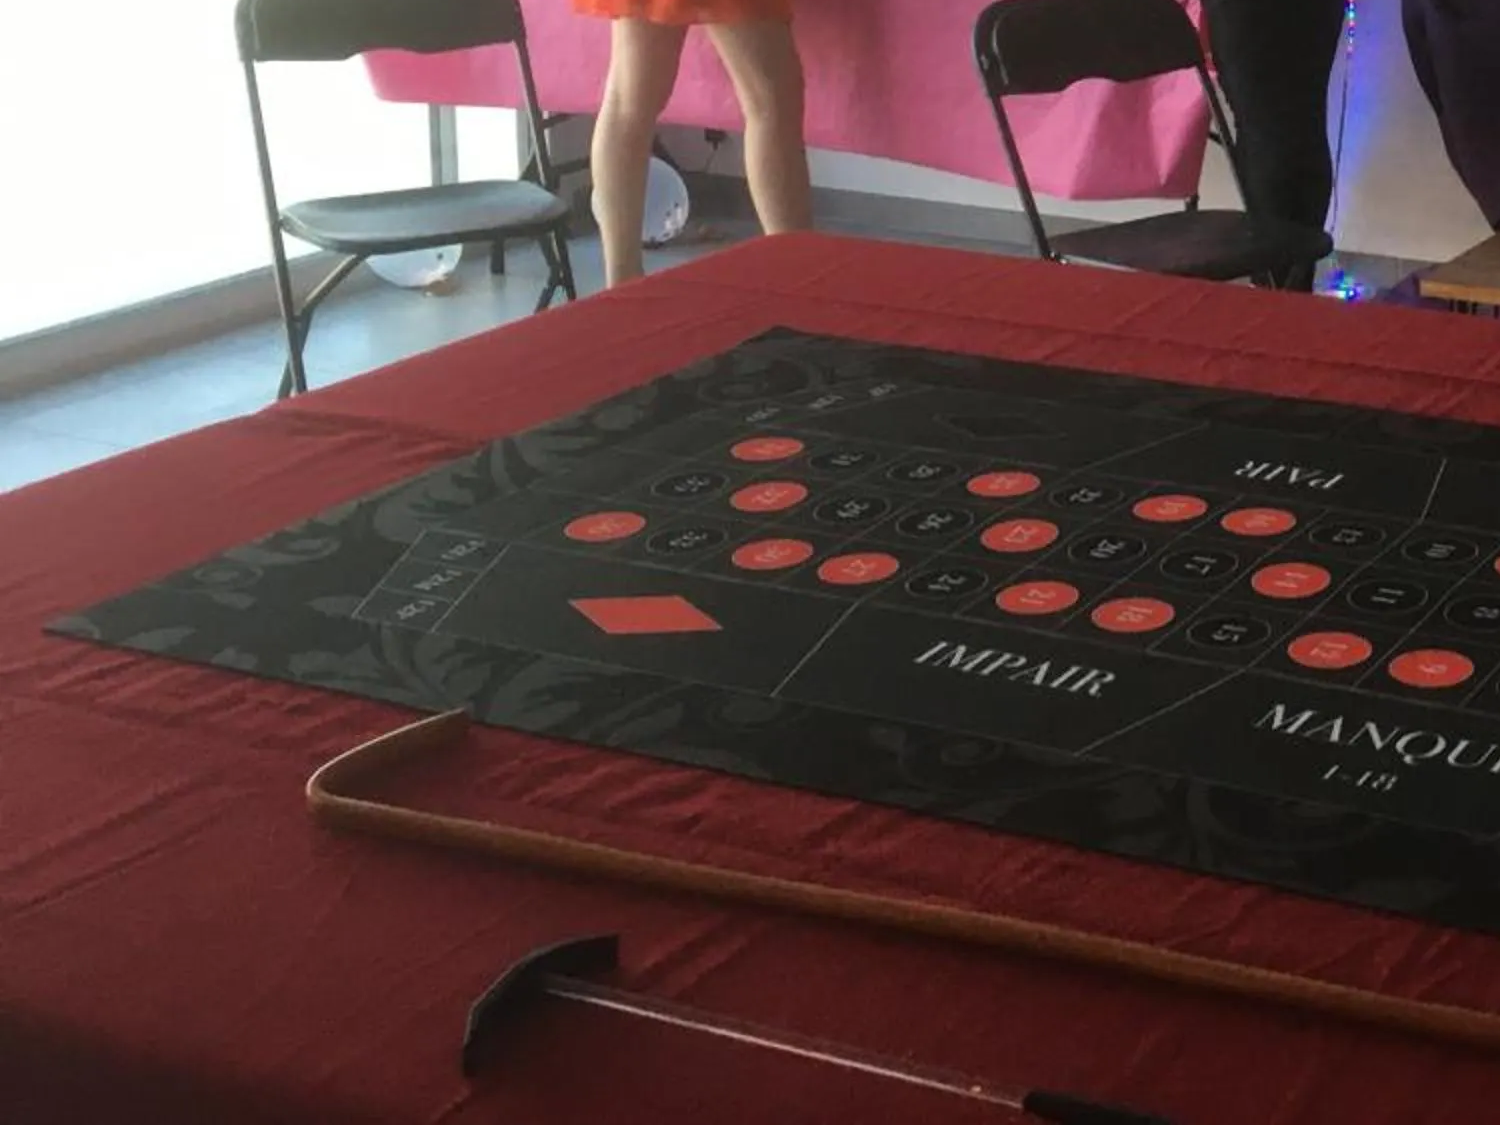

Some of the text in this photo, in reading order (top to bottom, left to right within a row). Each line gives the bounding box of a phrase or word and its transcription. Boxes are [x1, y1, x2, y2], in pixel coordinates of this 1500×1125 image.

[1234, 460, 1344, 489] PAIR
[913, 641, 1116, 698] IMPAIR
[1322, 764, 1399, 791] 1-18
